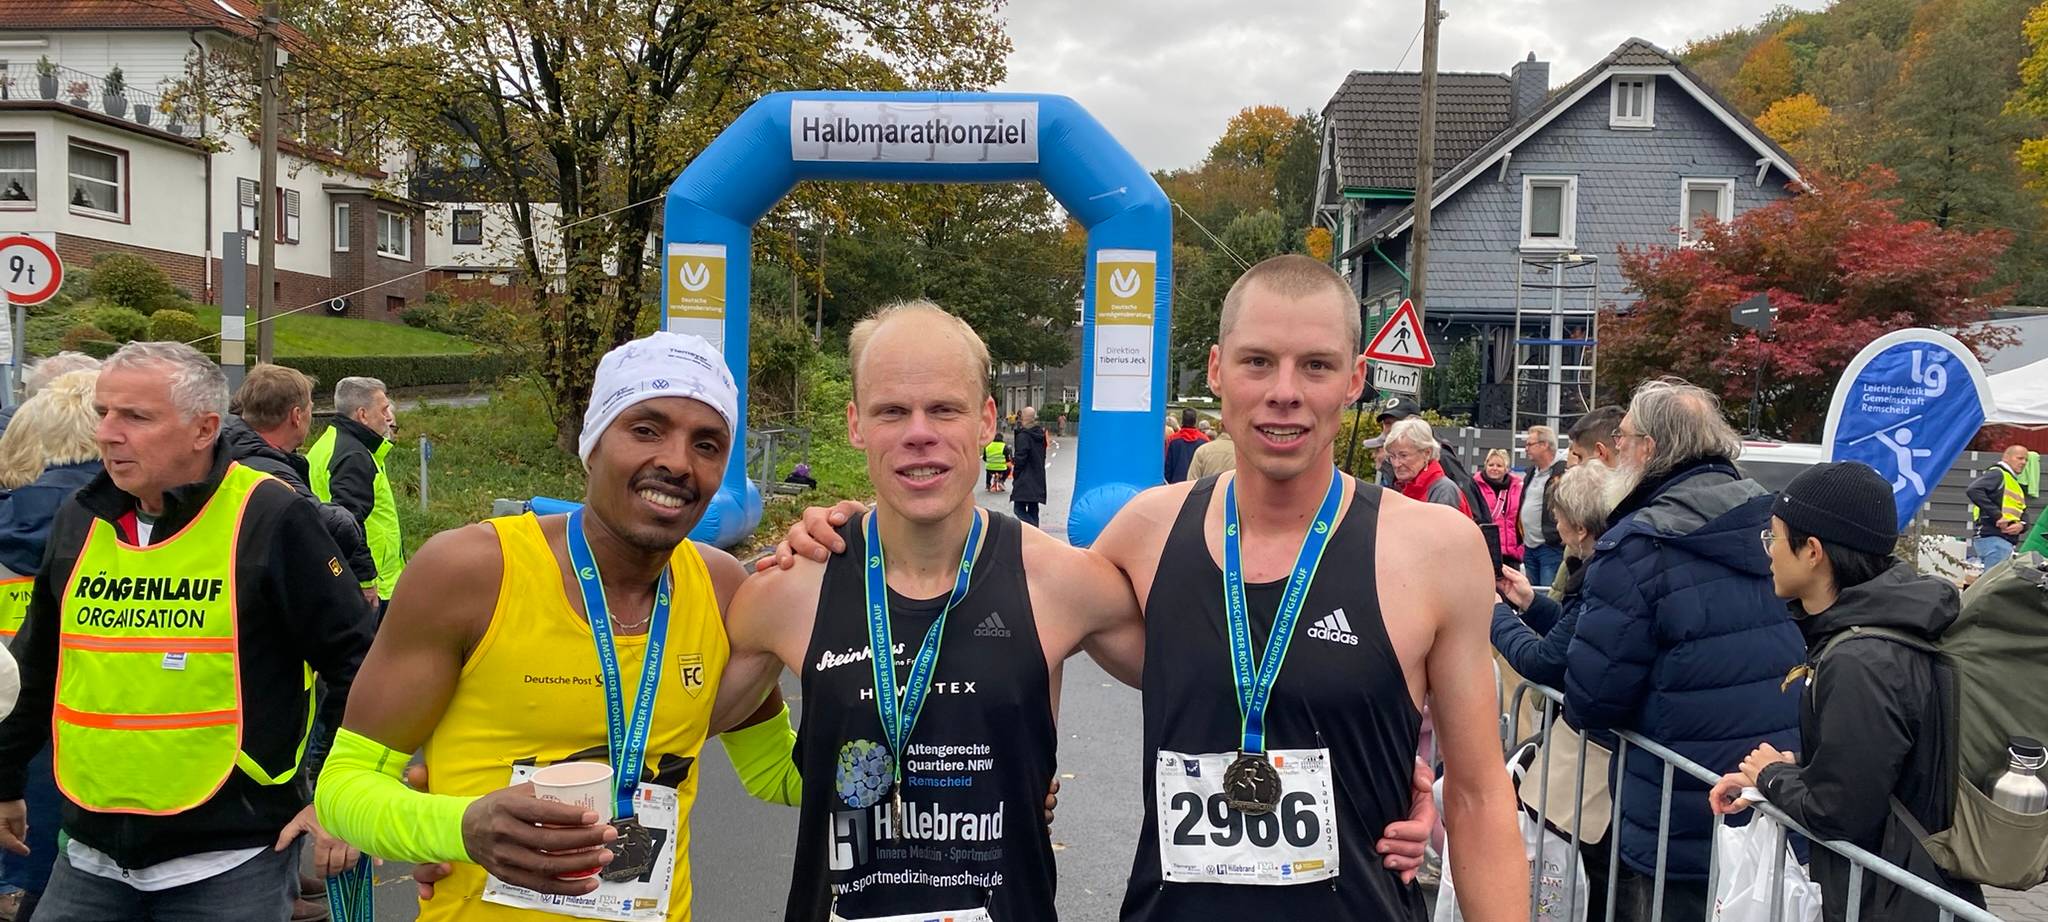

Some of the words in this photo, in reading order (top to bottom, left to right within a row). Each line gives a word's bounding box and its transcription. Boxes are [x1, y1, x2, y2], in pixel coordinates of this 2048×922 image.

[802, 116, 1027, 145] Halbmarathonziel
[1106, 346, 1140, 355] Direktion
[1099, 356, 1129, 364] Tiberius
[1130, 356, 1146, 364] Jeck
[1862, 393, 1925, 405] Gemeinschaft
[1861, 402, 1910, 415] Remscheid
[1279, 567, 1308, 635] RÖNTGENLAUF
[873, 603, 889, 669] RÖNTGENLAUF
[973, 627, 1011, 638] adidas
[1307, 627, 1359, 646] adidas
[524, 674, 572, 685] Deutsche
[572, 676, 592, 685] Post
[640, 640, 661, 709] RÖNTGENLAUF
[683, 666, 702, 686] FC
[907, 743, 991, 758] Altengerechte
[908, 775, 973, 787] Remscheid
[874, 801, 1005, 841] Hllebrand
[876, 846, 907, 860] Innere
